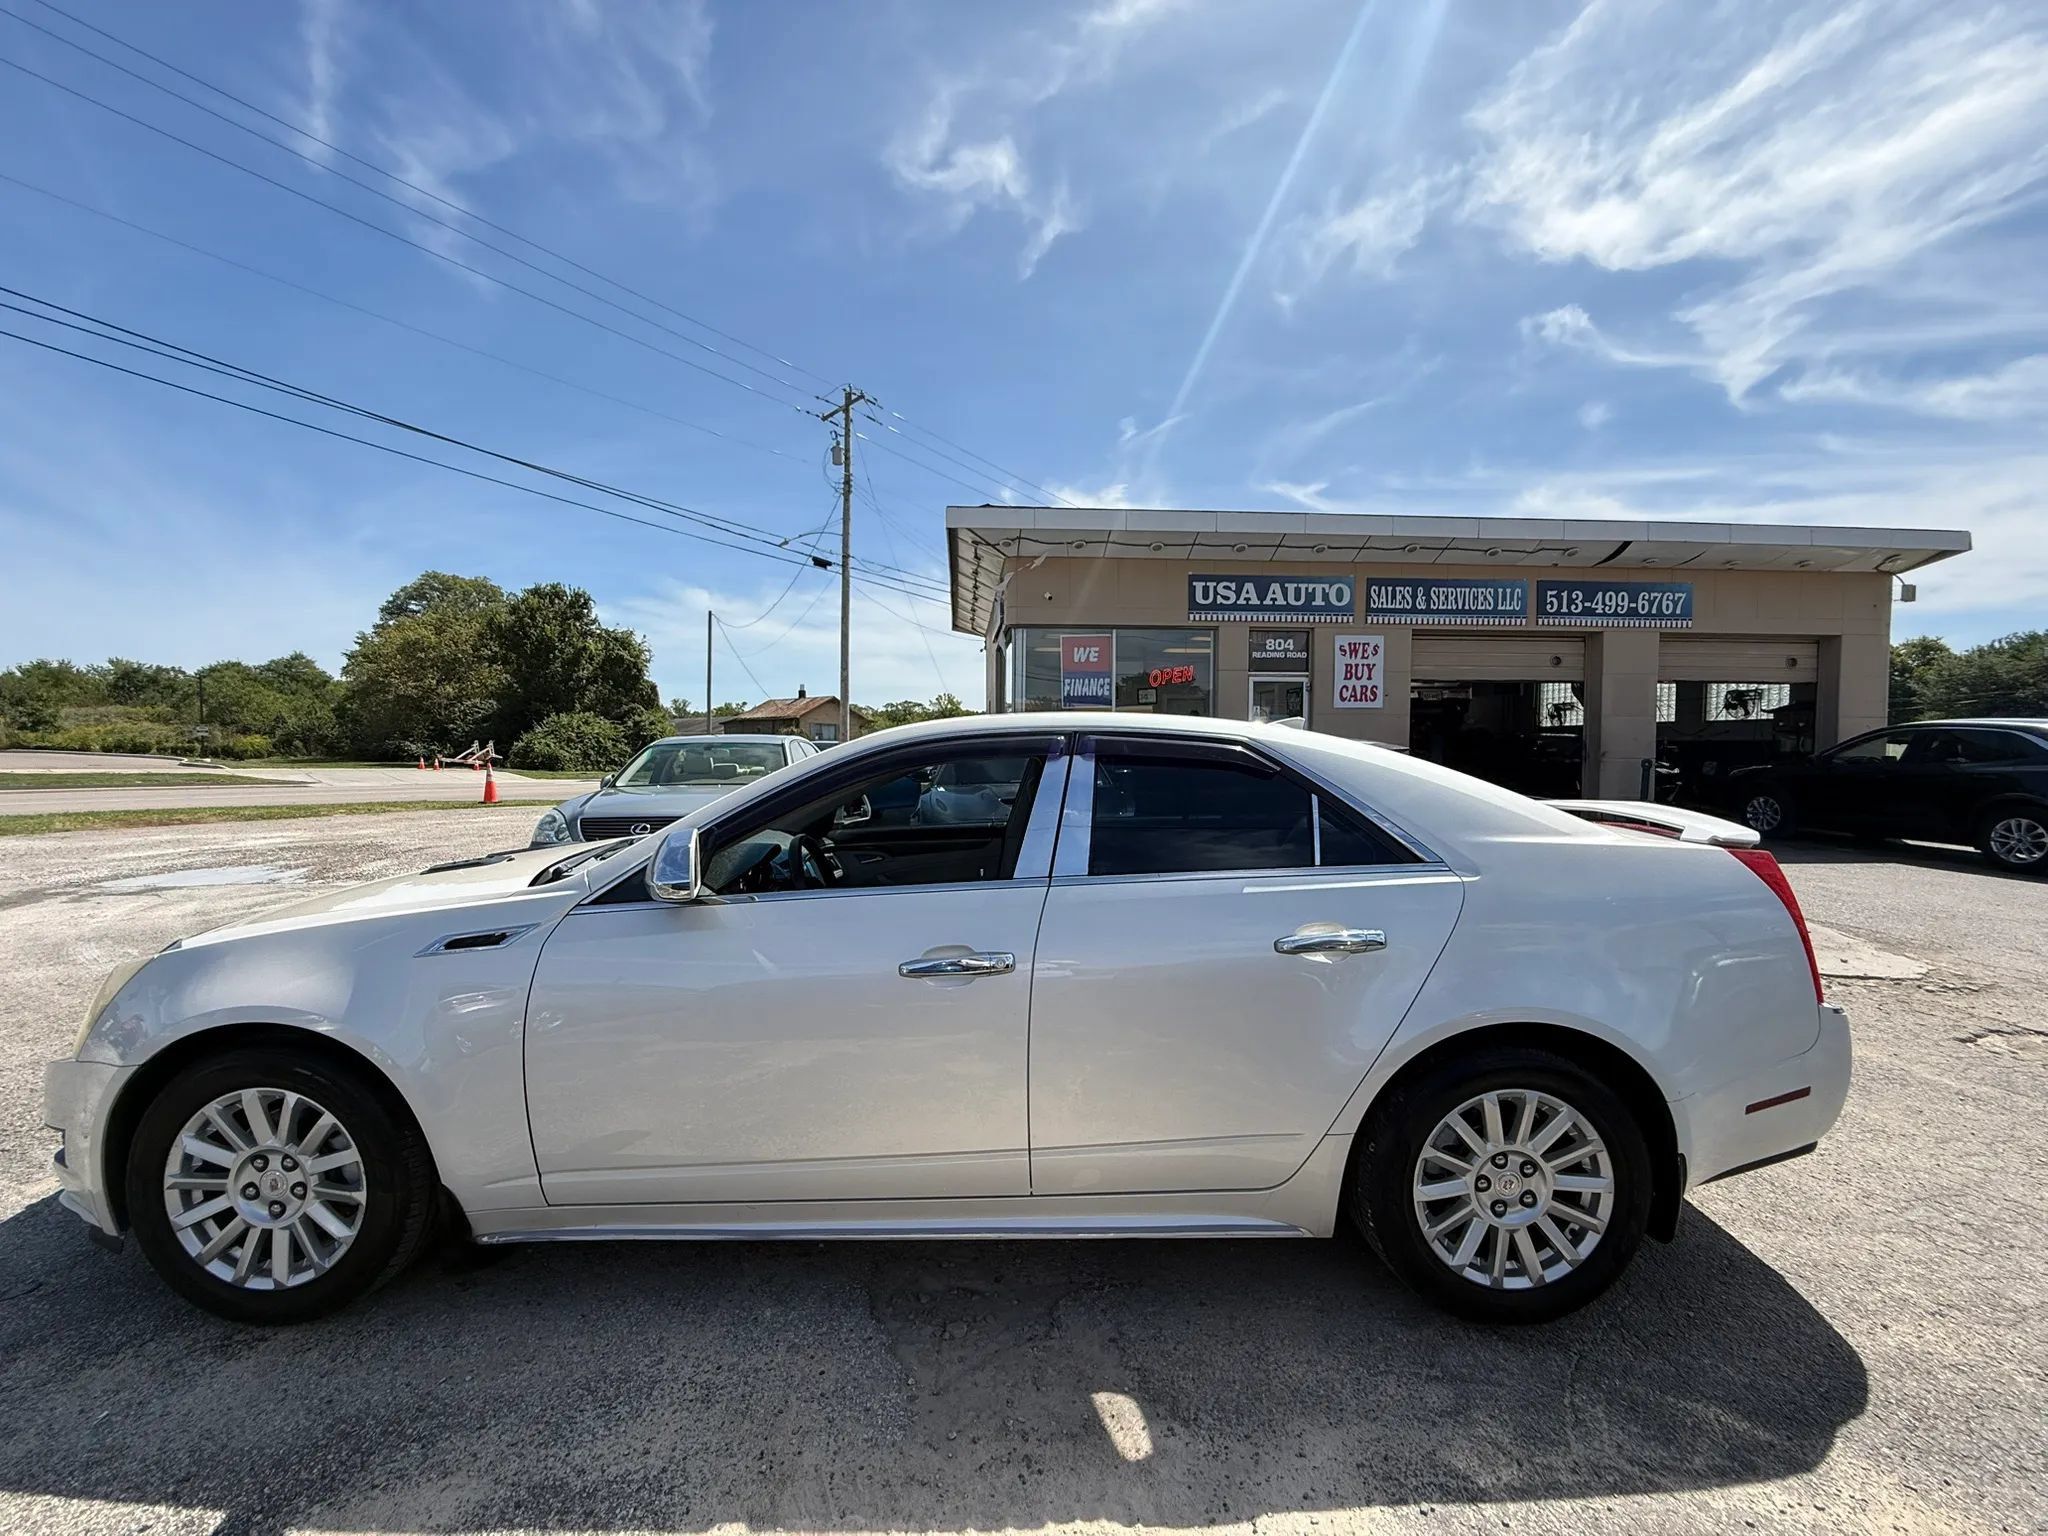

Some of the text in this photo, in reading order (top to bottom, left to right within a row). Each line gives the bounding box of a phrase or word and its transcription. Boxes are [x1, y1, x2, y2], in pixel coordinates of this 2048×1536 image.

[1192, 581, 1351, 607] USA AUTO
[1370, 585, 1522, 611] SALES & SERVICES LLC
[1545, 590, 1687, 615] 513-499-6767
[1265, 638, 1295, 651] 804
[1073, 646, 1100, 663] WE
[1252, 651, 1308, 659] READING ROAD
[1149, 665, 1195, 687] OPEN
[1343, 663, 1377, 681] BUY
[1064, 678, 1111, 697] FINANCE
[1339, 684, 1379, 703] CARS
